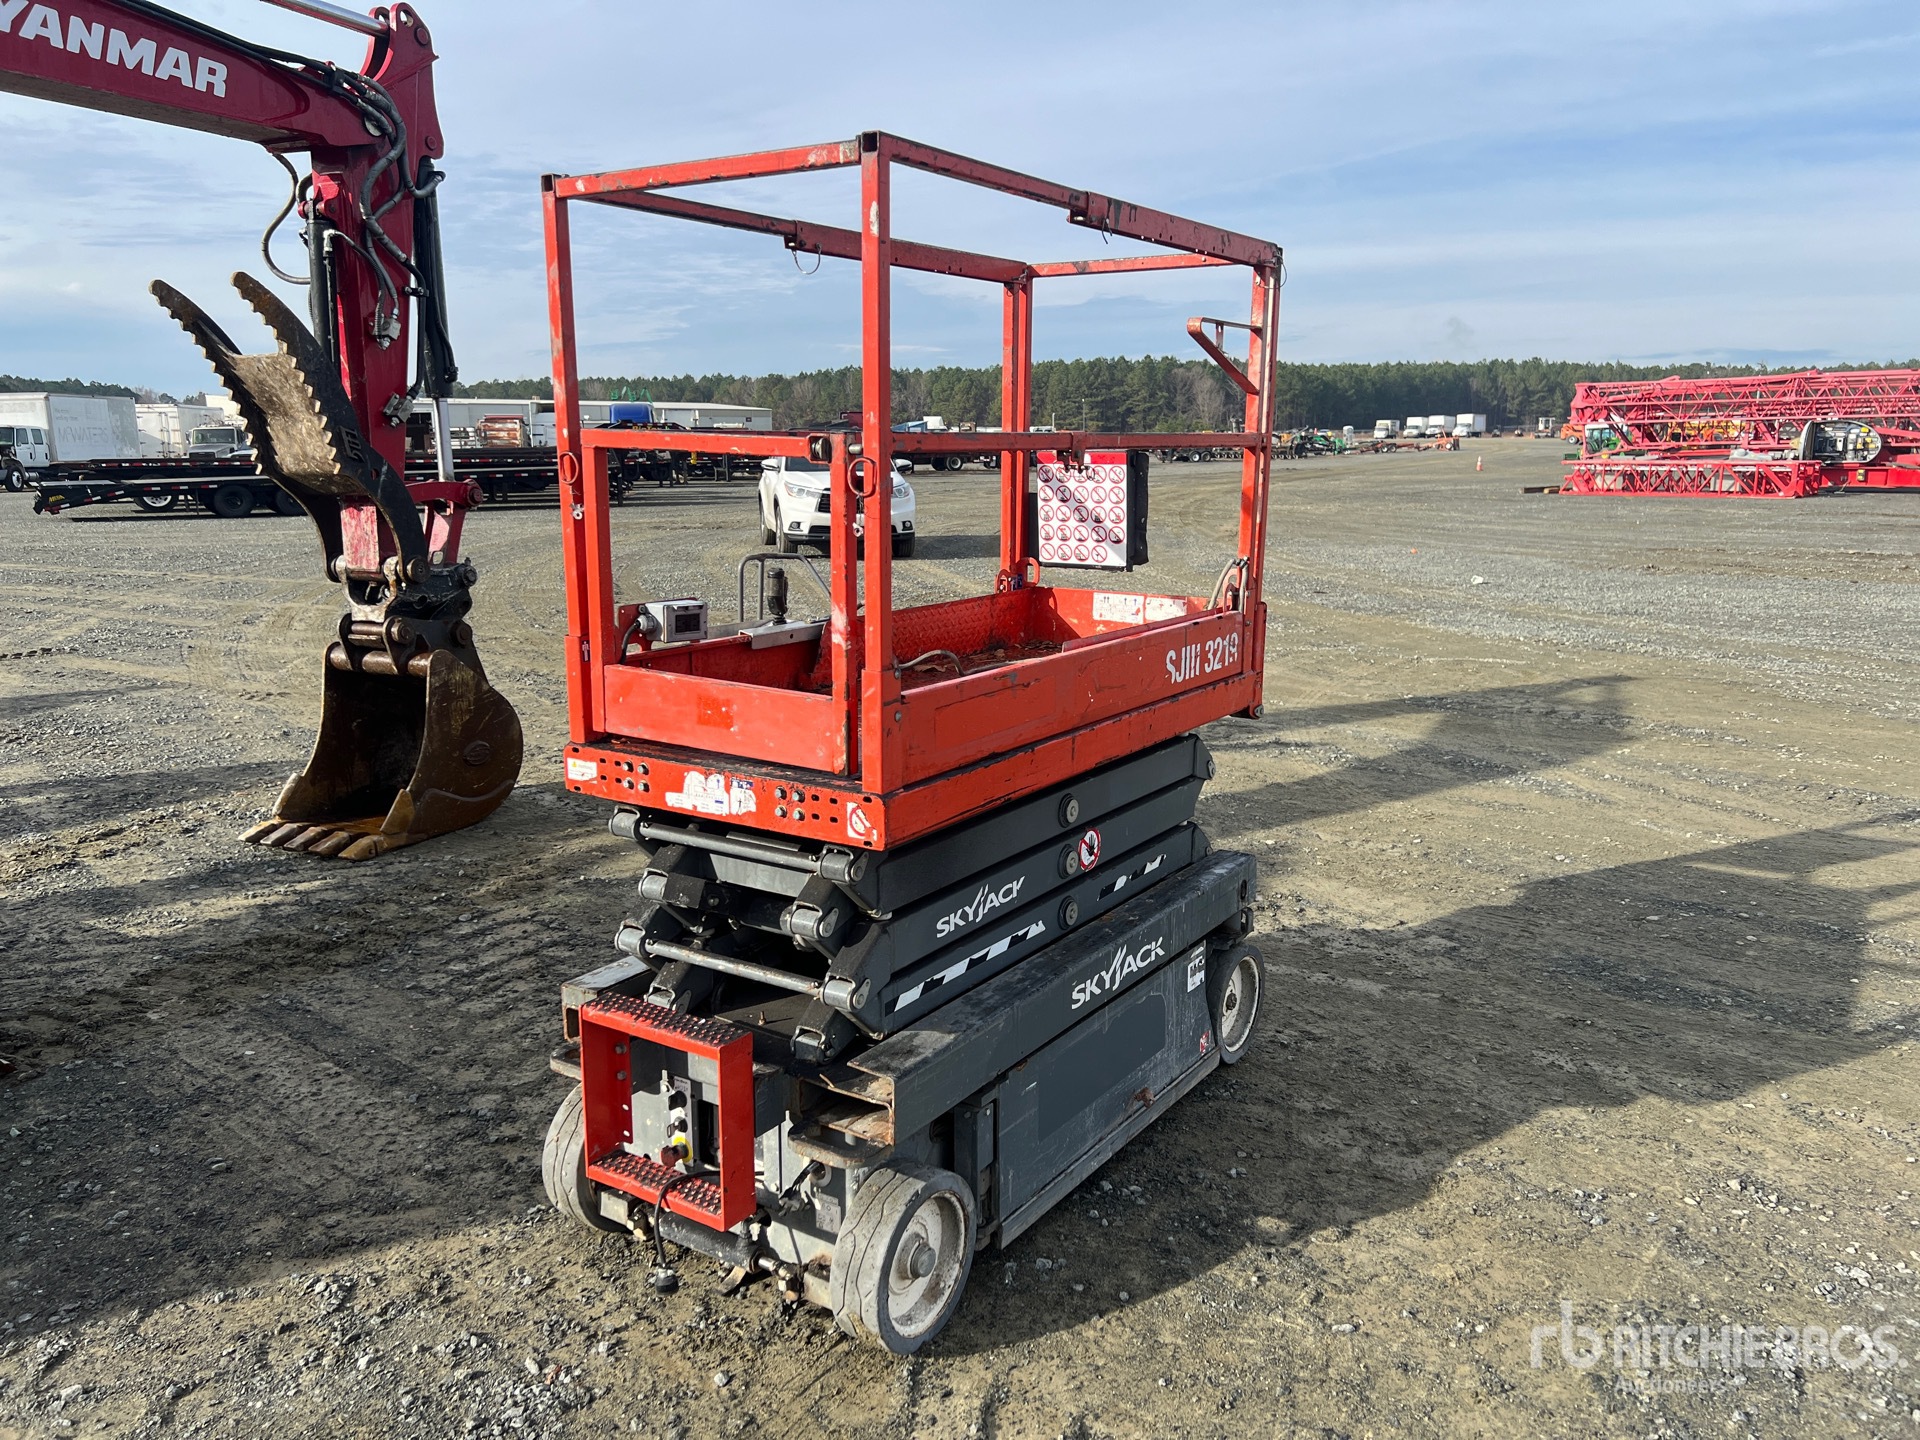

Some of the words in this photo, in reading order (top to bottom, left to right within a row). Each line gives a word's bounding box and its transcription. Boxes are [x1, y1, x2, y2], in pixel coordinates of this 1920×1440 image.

[0, 0, 228, 98] YANMAR
[1204, 632, 1238, 673] 3219
[936, 876, 1026, 938] SKYJACK
[1071, 936, 1165, 1010] SKYJACK
